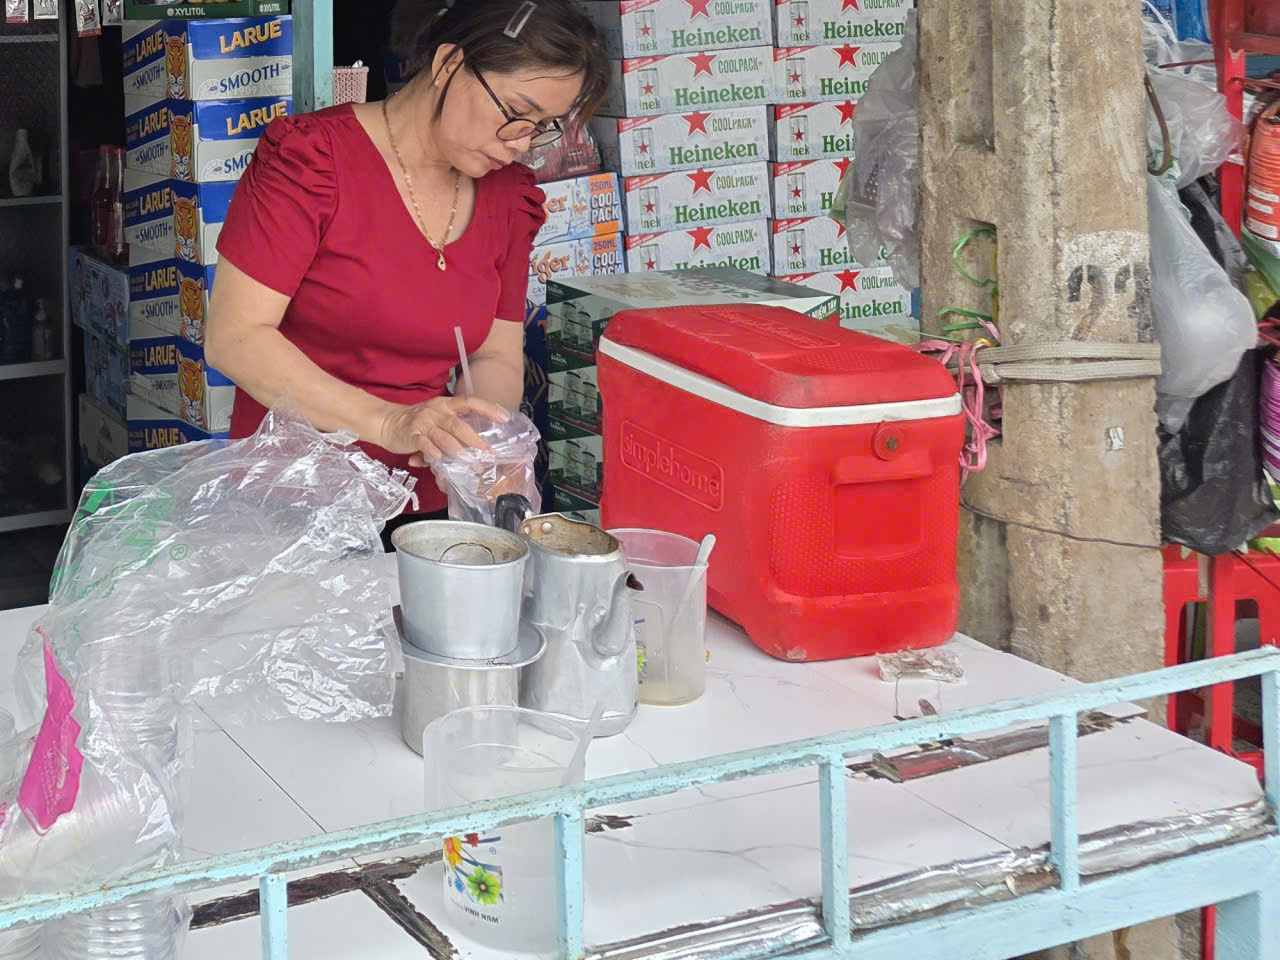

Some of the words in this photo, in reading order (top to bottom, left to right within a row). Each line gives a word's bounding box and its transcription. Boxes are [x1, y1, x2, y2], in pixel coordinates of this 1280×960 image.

[175, 7, 206, 16] XYLITOL
[220, 19, 283, 54] LARUE
[672, 25, 762, 48] Heineken
[823, 18, 904, 40] Heineken
[136, 29, 164, 62] LARUE
[220, 62, 280, 93] SMOOTH
[820, 77, 870, 97] Heine
[674, 83, 766, 107] Heineken
[139, 106, 168, 139] LARUE
[227, 101, 288, 137] LARUE
[224, 150, 253, 174] SMO
[669, 140, 759, 166] Heineken
[589, 181, 615, 192] 250ML
[139, 187, 171, 216] LARUE
[590, 193, 618, 208] COOL
[674, 197, 761, 225] Heineken
[590, 205, 619, 222] PACK
[593, 239, 617, 251] 250ML
[529, 248, 570, 284] iger
[593, 252, 622, 267] COOL
[145, 265, 177, 293] LARUE
[144, 343, 176, 368] LARUE
[622, 433, 721, 497] simplehome
